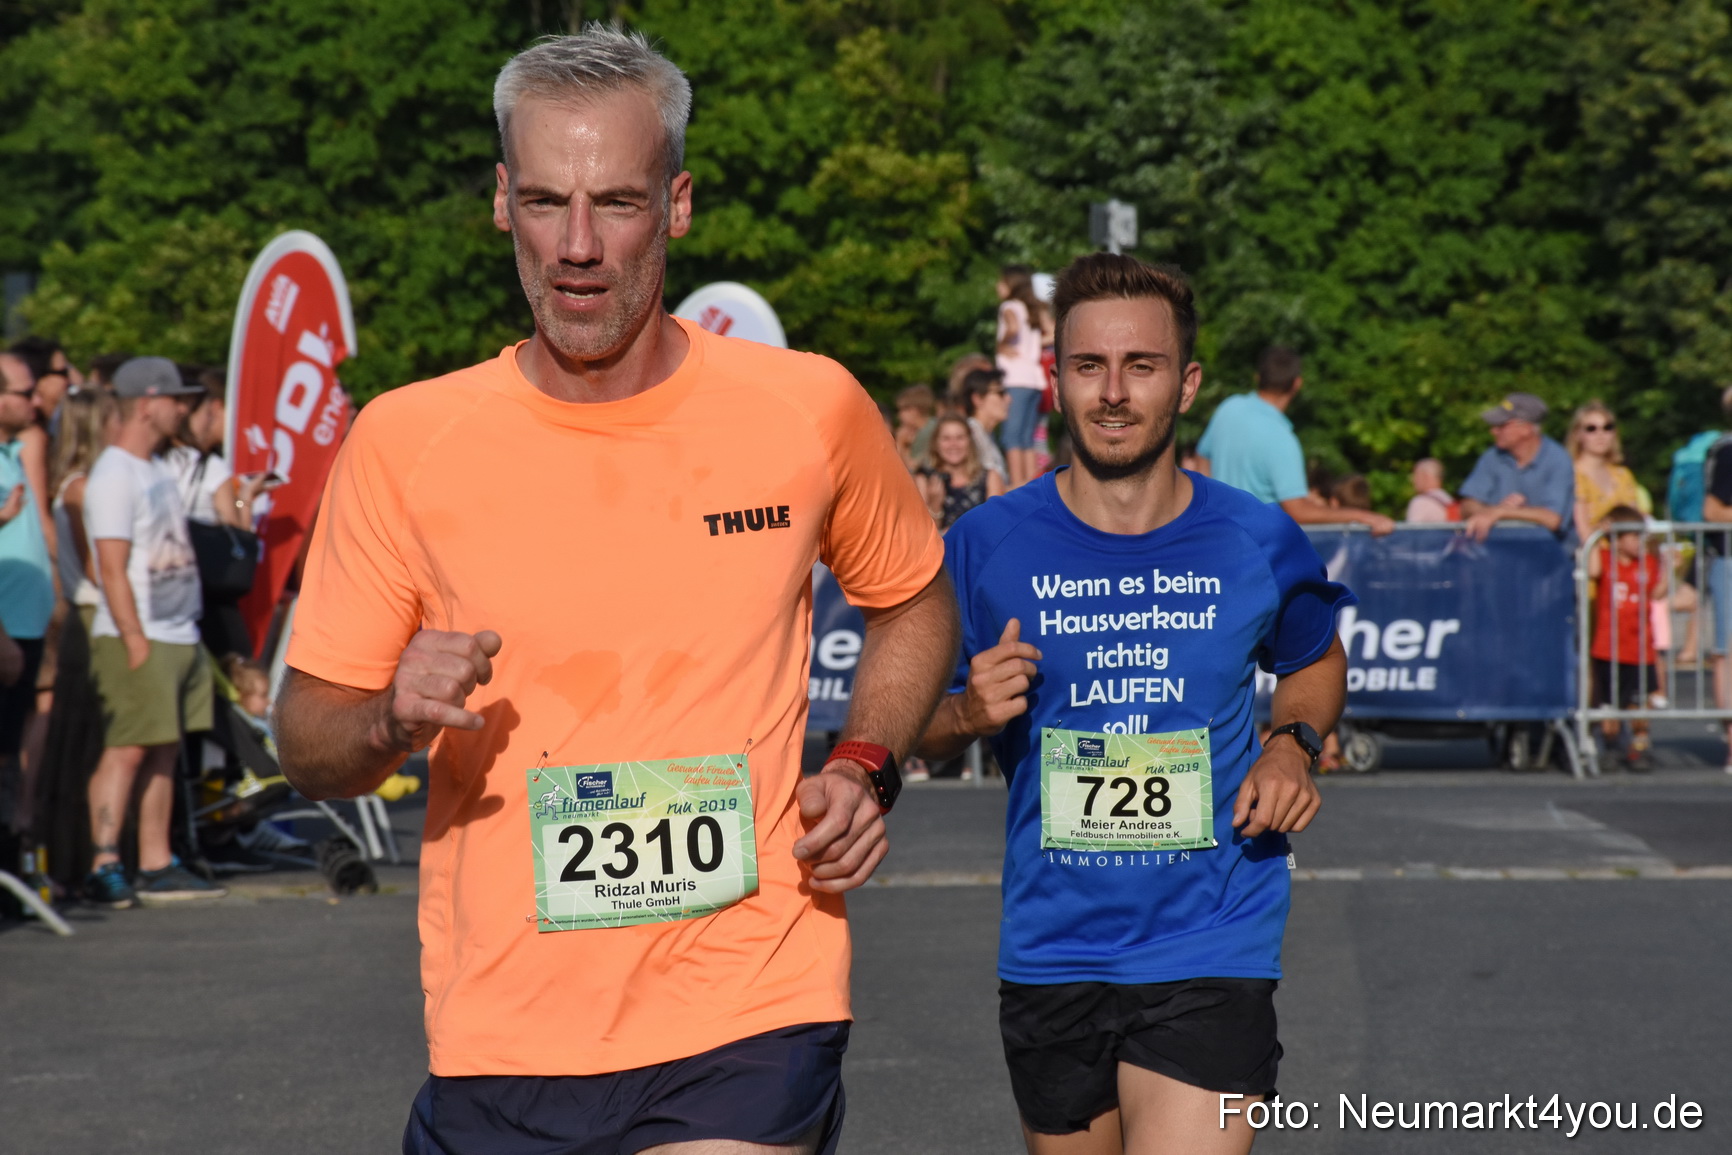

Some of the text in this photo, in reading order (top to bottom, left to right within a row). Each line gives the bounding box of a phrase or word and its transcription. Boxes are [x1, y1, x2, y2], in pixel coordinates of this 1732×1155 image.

[703, 505, 790, 536] THULE
[1032, 568, 1221, 599] Wenn es beim
[1040, 604, 1217, 636] Hausverkauf
[1337, 605, 1460, 660] her
[1086, 642, 1169, 670] richtig
[1346, 666, 1437, 692] OBILE
[1070, 677, 1185, 708] LAUFEN
[1102, 714, 1149, 736] soll!
[1066, 754, 1130, 768] firmenlauf
[1169, 762, 1199, 774] 2019
[562, 792, 647, 813] firmenlauf
[699, 798, 737, 813] 2019
[1077, 775, 1172, 818] 728
[562, 812, 600, 820] neumarkt
[1081, 819, 1172, 830] Meier Andreas
[1070, 830, 1183, 840] Feldbusch Immobilien e.K.
[558, 815, 724, 882] 2310
[1049, 851, 1191, 867] IMMOBILIEN
[594, 878, 697, 898] Ridzal Muris
[611, 896, 681, 910] Thule GmbH
